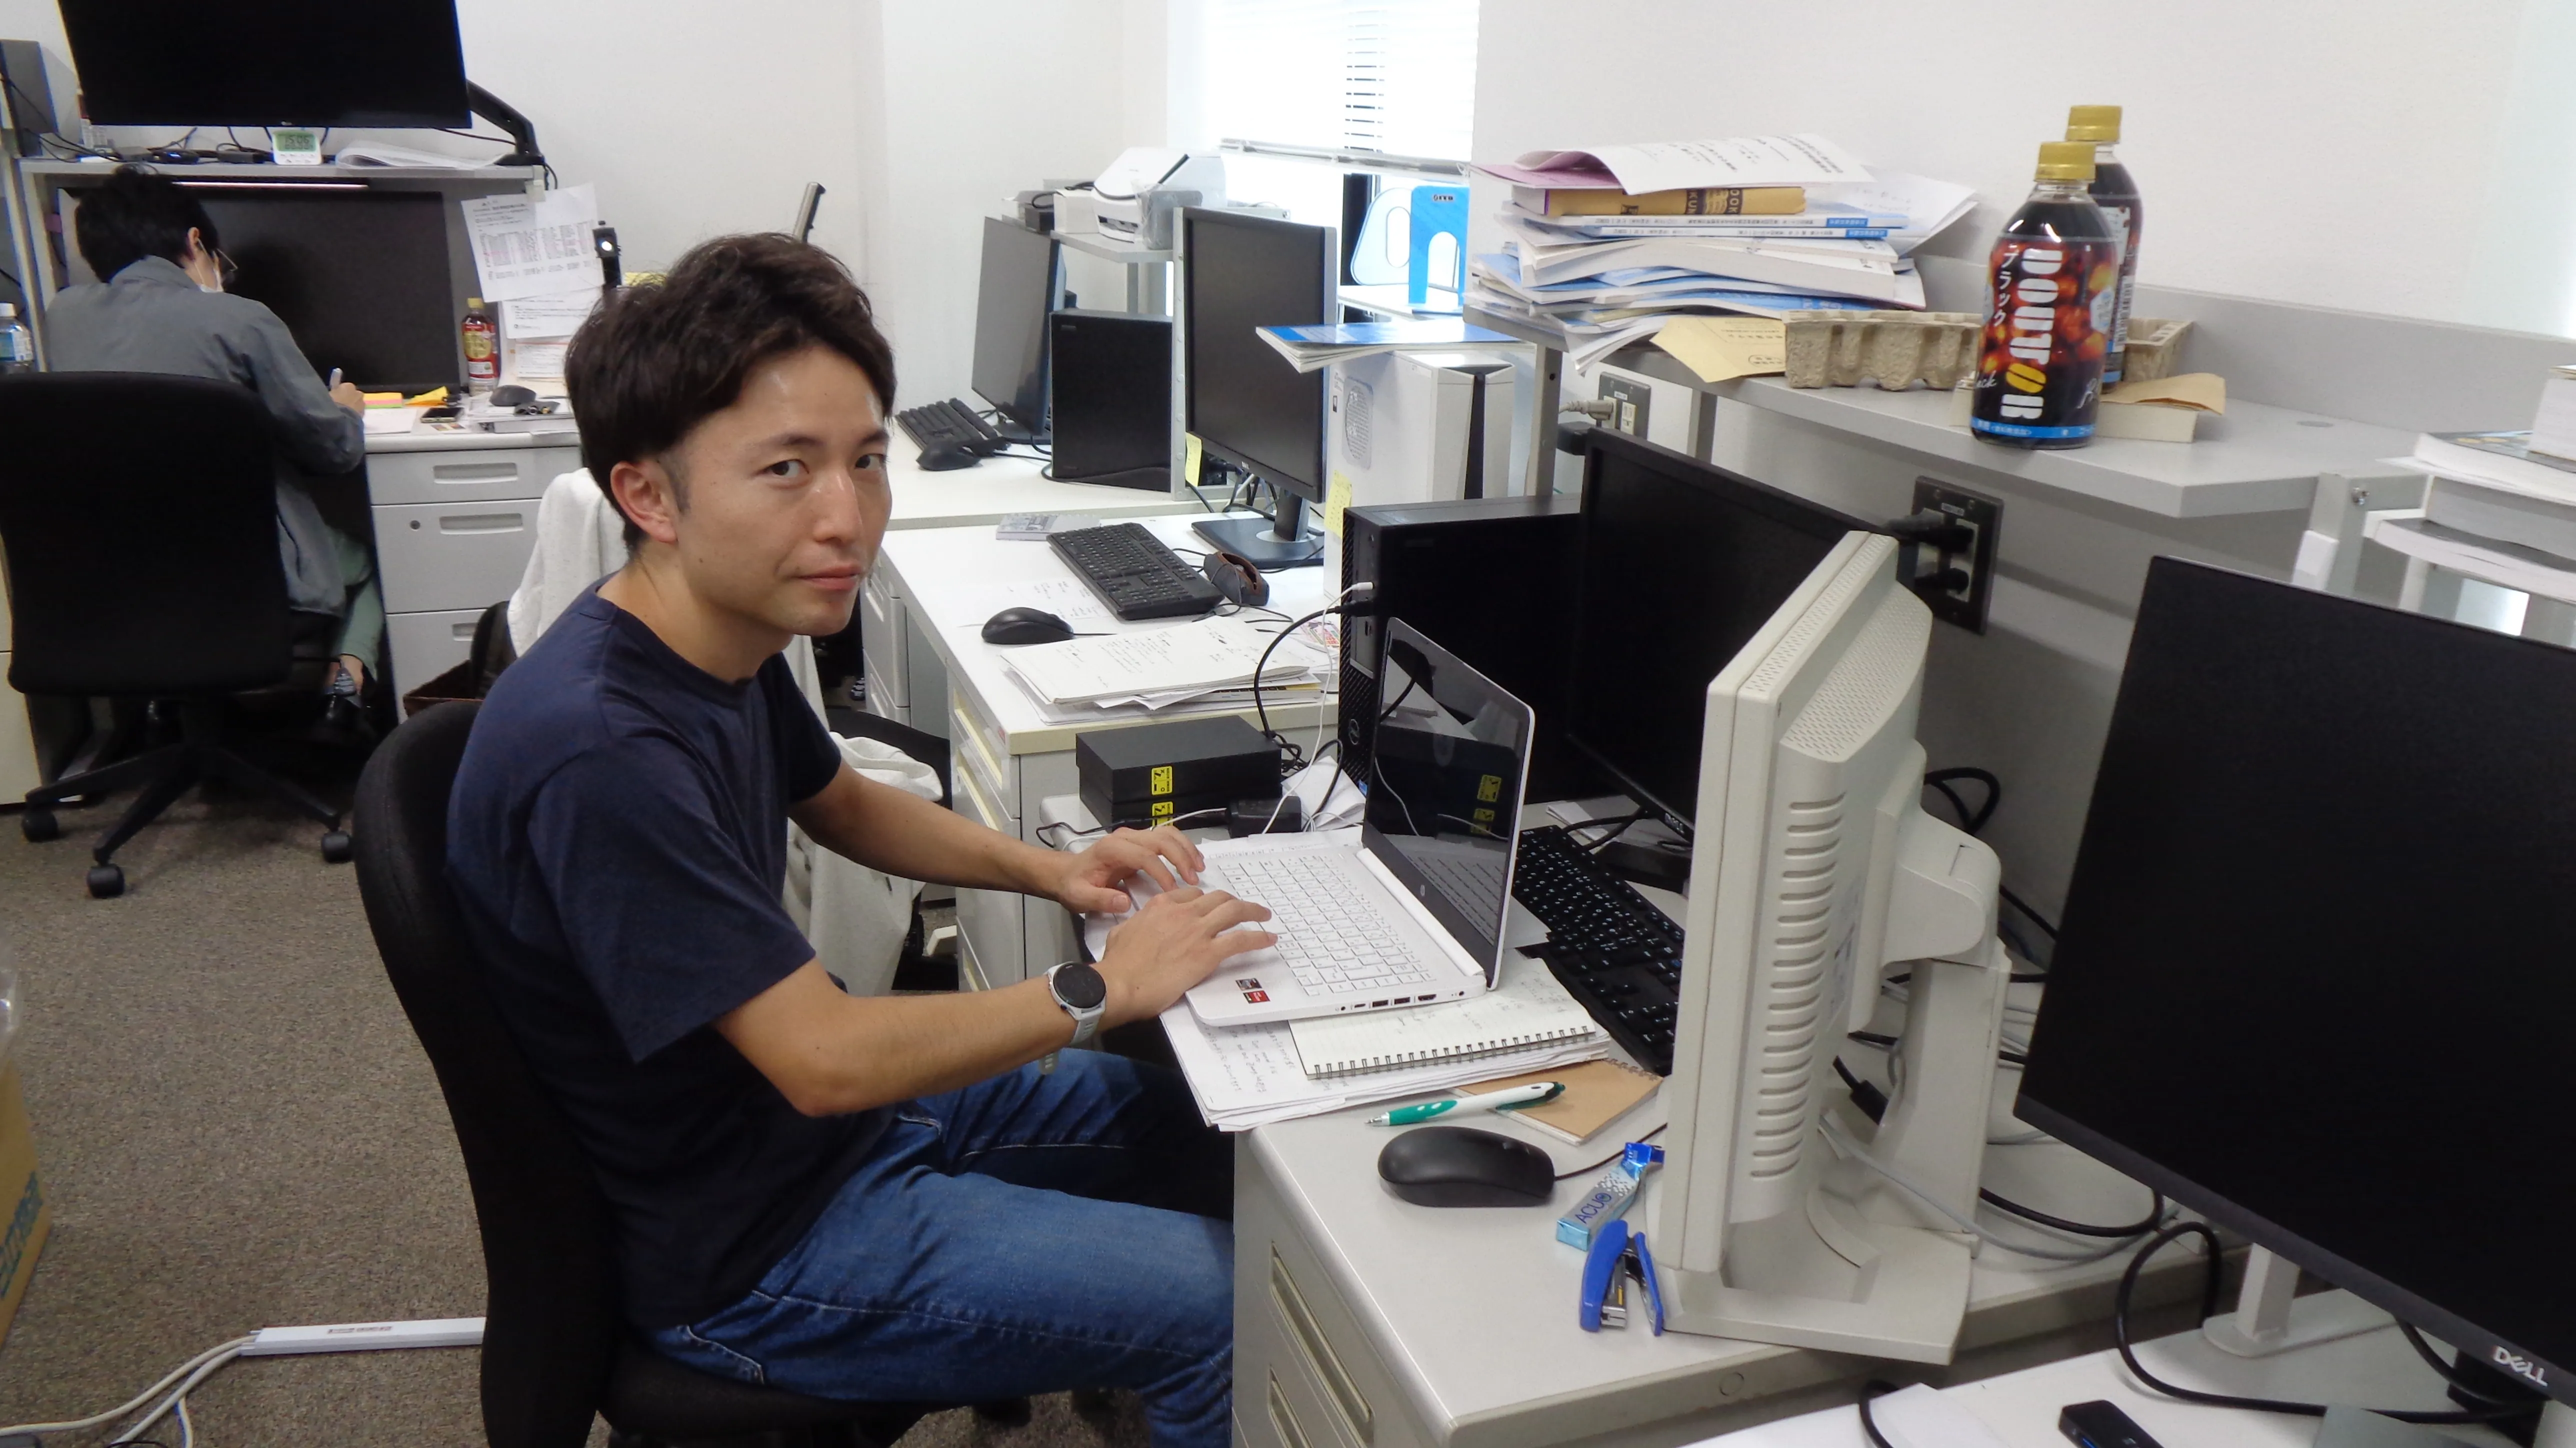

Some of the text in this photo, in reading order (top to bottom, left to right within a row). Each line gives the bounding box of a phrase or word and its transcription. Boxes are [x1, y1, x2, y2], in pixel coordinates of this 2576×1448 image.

[1993, 250, 2019, 327] ブラック
[2000, 248, 2062, 419] DOUTOR
[1574, 1192, 1612, 1224] ACUO
[2492, 1344, 2549, 1387] DELL
